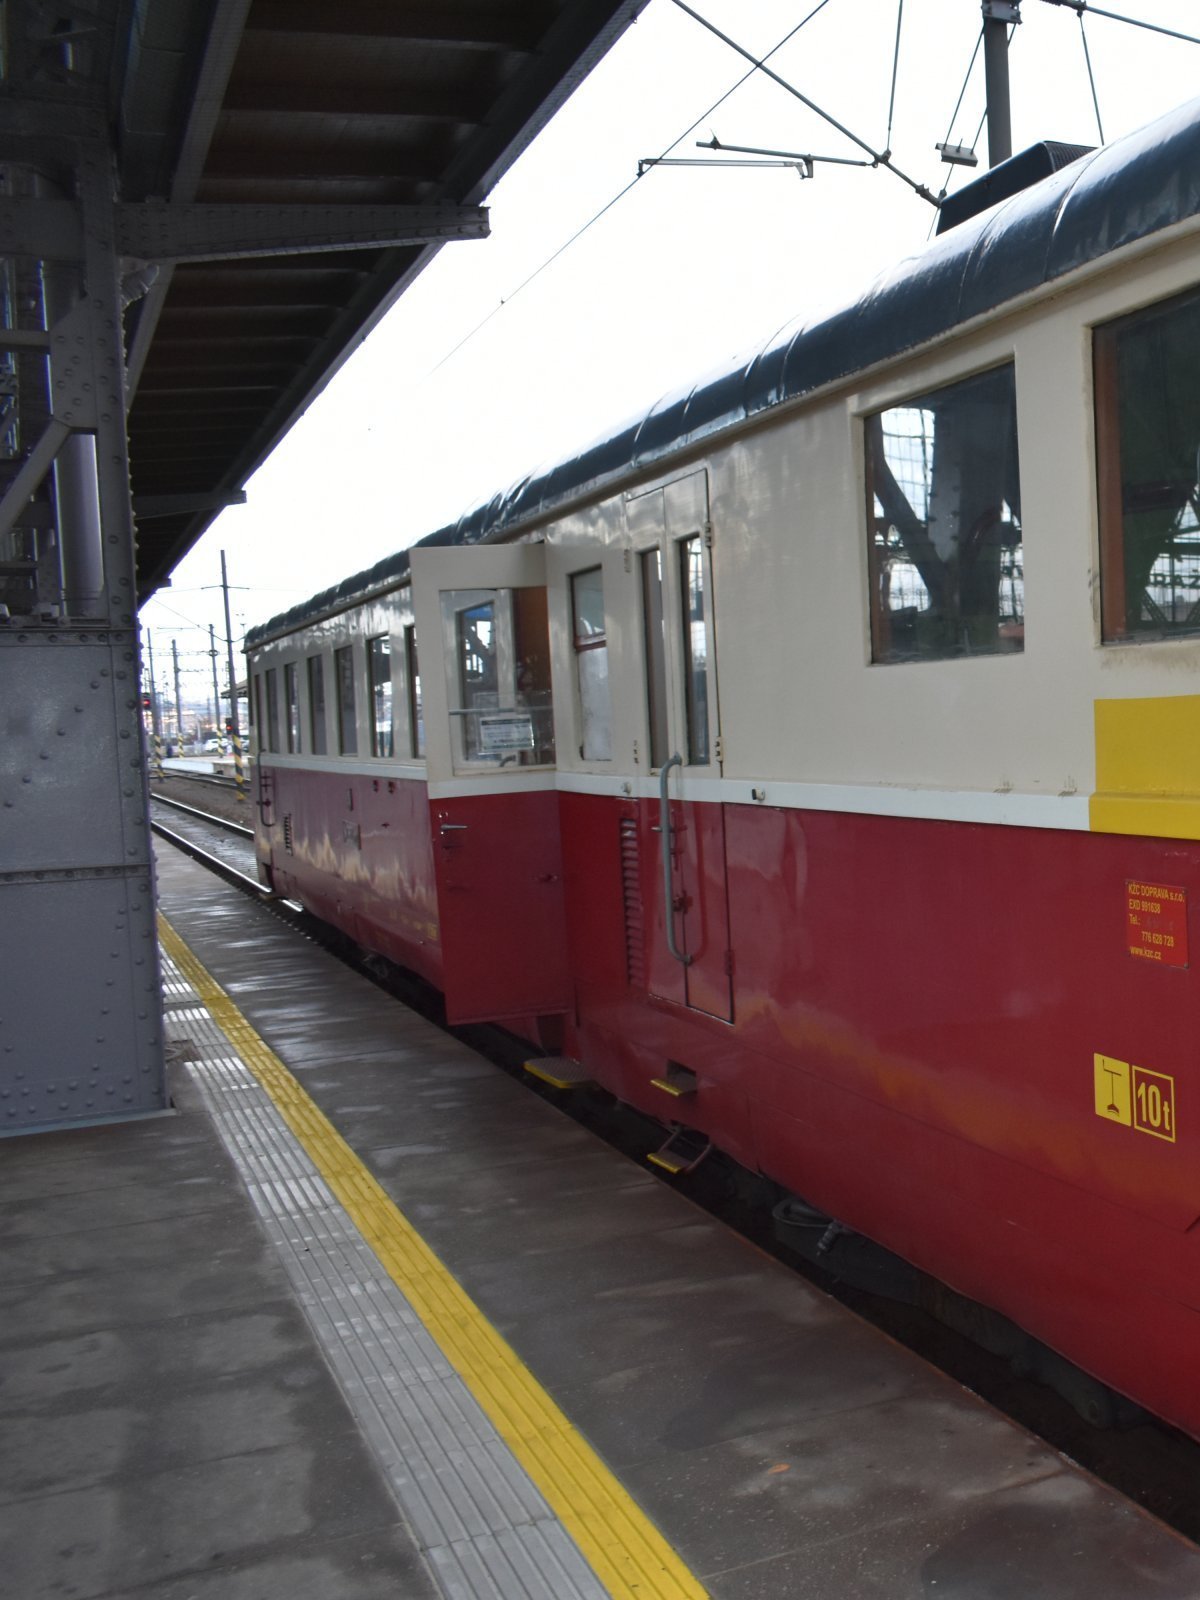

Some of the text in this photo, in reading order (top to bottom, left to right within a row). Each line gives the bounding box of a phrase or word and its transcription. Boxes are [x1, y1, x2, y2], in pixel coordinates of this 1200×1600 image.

[1141, 885, 1169, 899] DOPRAVA
[1169, 892, 1185, 902] s.r.o.
[1130, 946, 1162, 960] www.kzc.cz
